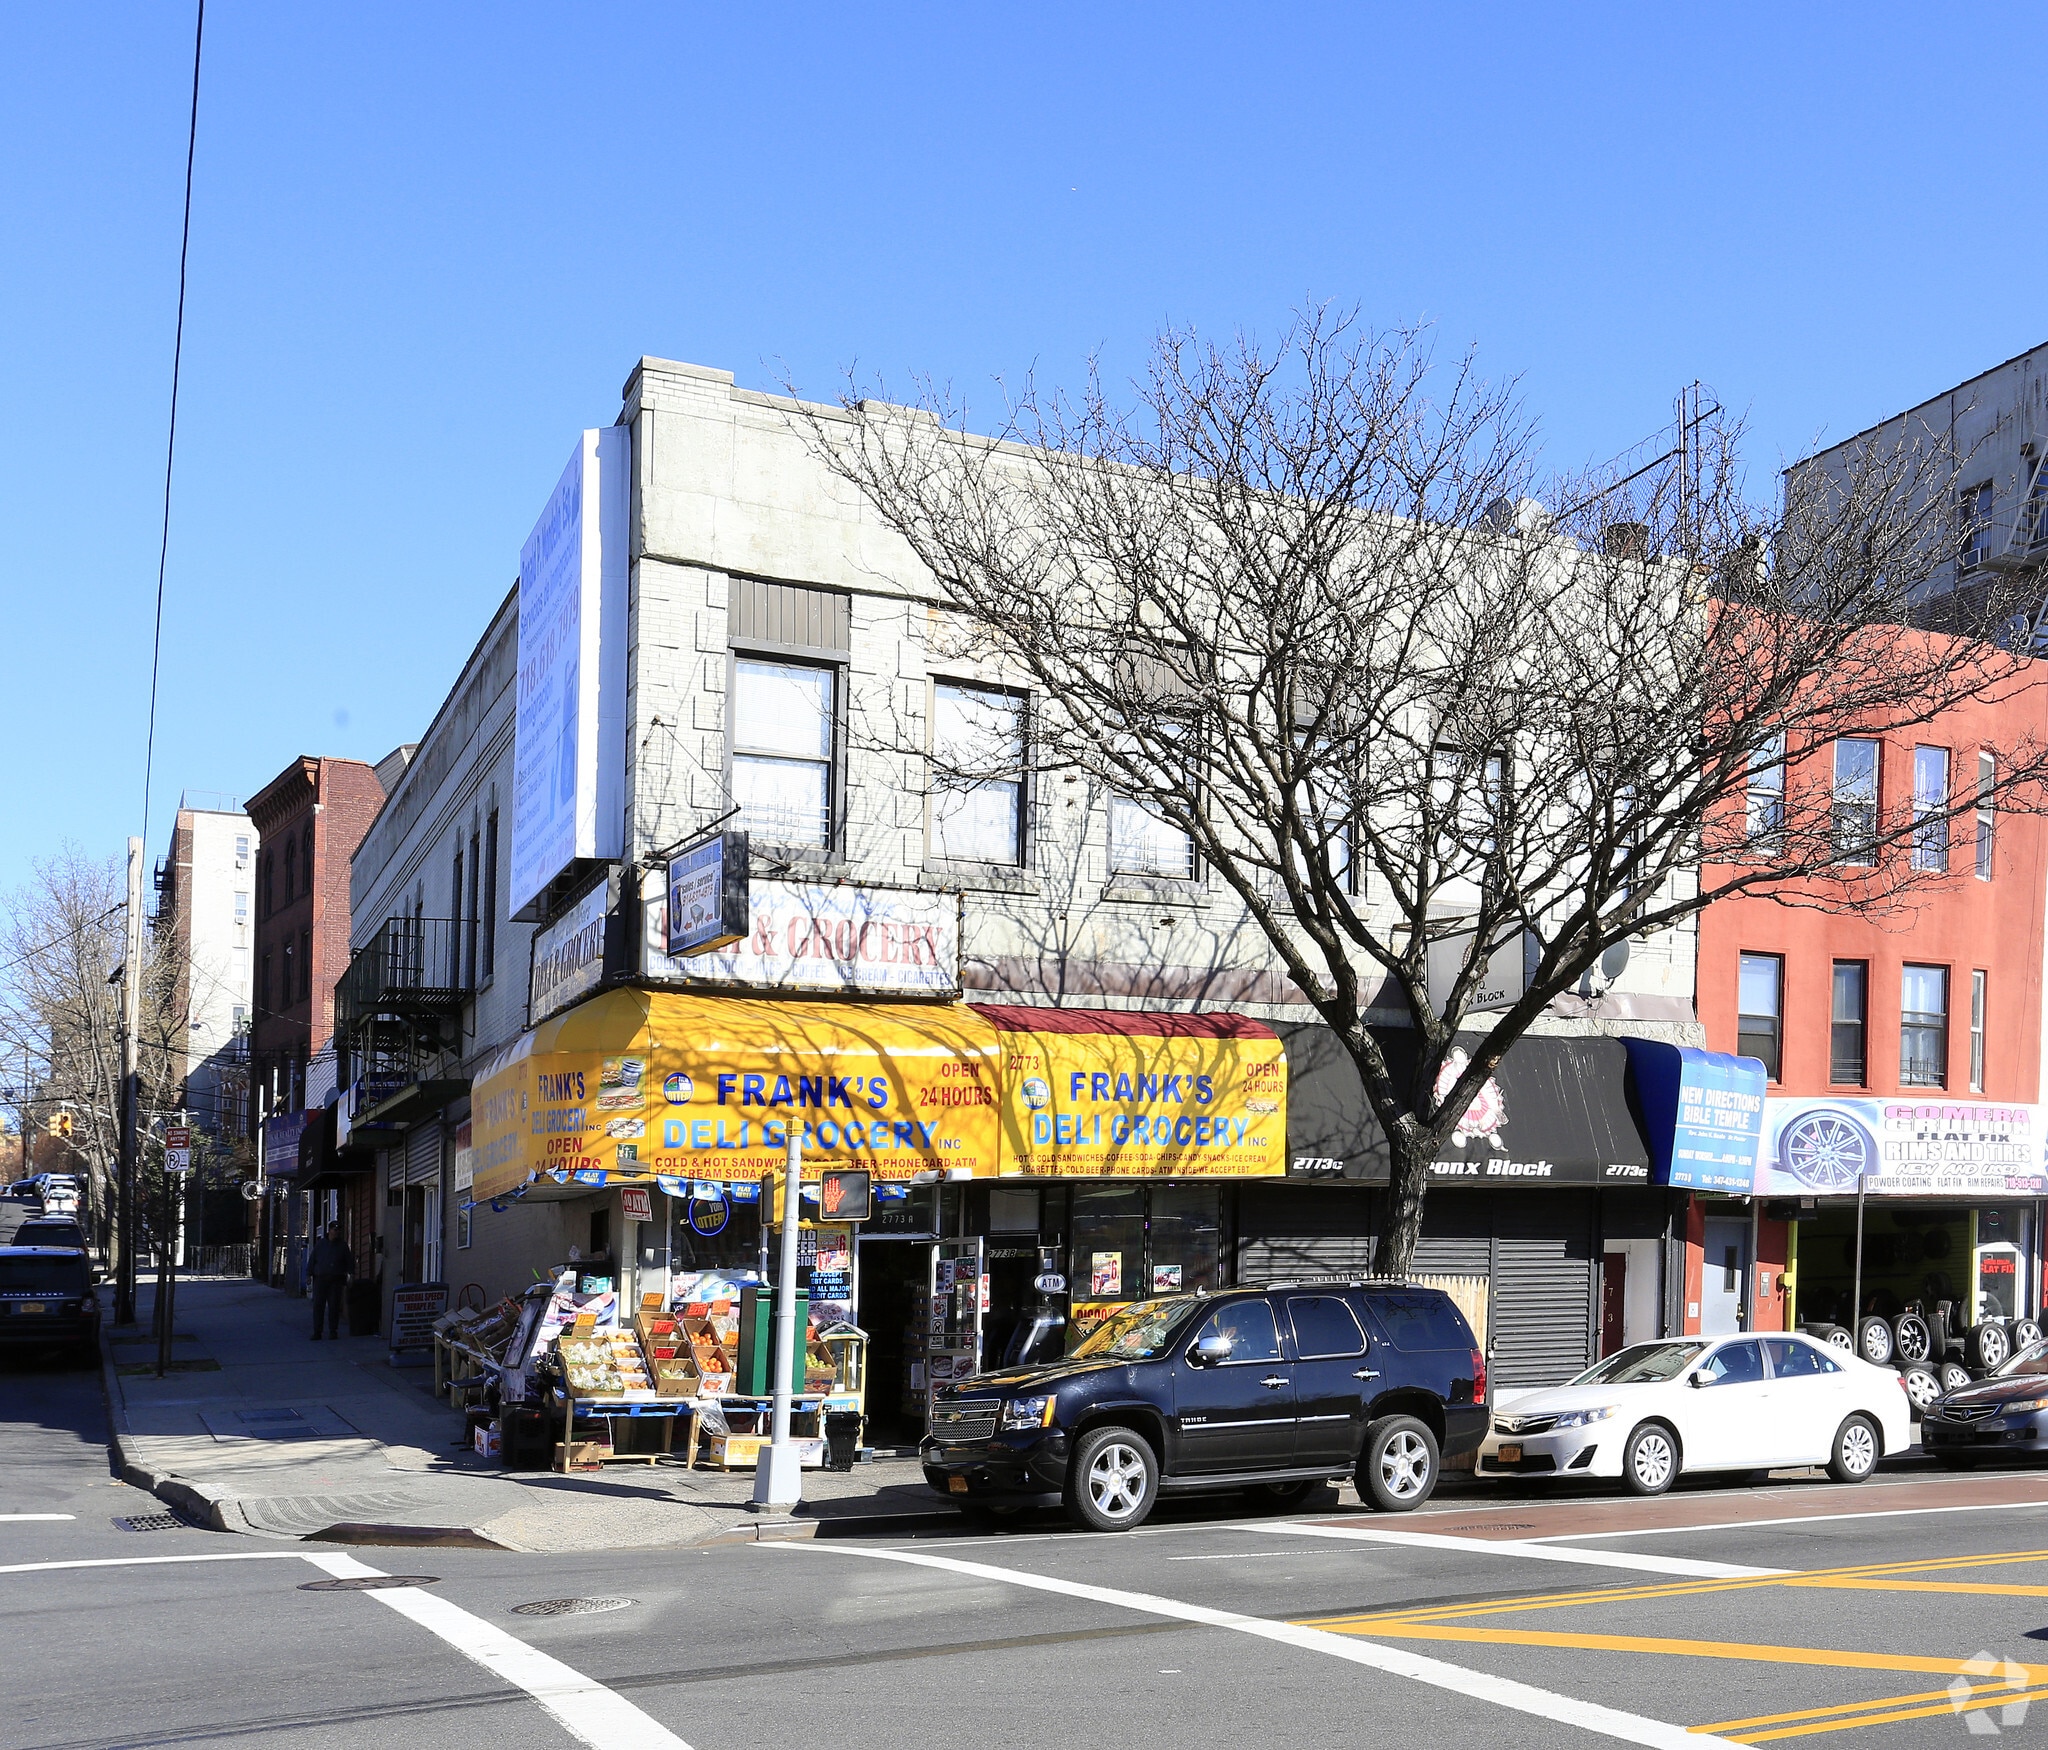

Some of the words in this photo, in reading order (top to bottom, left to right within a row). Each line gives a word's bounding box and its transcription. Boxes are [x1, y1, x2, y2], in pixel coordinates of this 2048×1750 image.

[518, 582, 578, 710] 718.618.7979
[752, 915, 778, 956] &
[787, 915, 943, 967] GROCERY
[649, 955, 676, 971] COLD
[680, 958, 705, 972] BEER
[792, 964, 827, 979] COFFEE
[856, 967, 887, 982] CREAM
[898, 970, 951, 986] CIGARETTES
[941, 1062, 979, 1078] OPEN
[1010, 1055, 1040, 1070] 2773
[1246, 1062, 1280, 1077] OPEN
[538, 1071, 585, 1102] FRANK'S
[717, 1073, 889, 1109] FRANK'S
[1071, 1071, 1213, 1104] FRANK'S
[1243, 1081, 1253, 1093] 24
[1254, 1081, 1284, 1093] HOURS
[920, 1087, 938, 1106] 24
[941, 1086, 993, 1106] HOURS
[1681, 1085, 1704, 1104] NEW
[1705, 1089, 1760, 1113] DIRECTIONS
[531, 1111, 545, 1135] DELI
[546, 1108, 586, 1133] GROCERY
[1683, 1105, 1711, 1125] BIBLE
[1714, 1109, 1750, 1130] TEMPLE
[1884, 1105, 2030, 1123] GOMERA
[664, 1119, 749, 1149] DELI
[762, 1119, 939, 1150] GROCERY
[938, 1138, 962, 1150] INC
[1034, 1113, 1101, 1145] DELI
[1111, 1114, 1250, 1147] GROCERY
[1248, 1137, 1268, 1146] INC
[1917, 1132, 1972, 1141] FLAT
[1979, 1133, 2010, 1142] FIX
[547, 1137, 583, 1154] OPEN
[1885, 1141, 1942, 1161] RIMS
[1944, 1142, 1984, 1162] AND
[1986, 1143, 2032, 1163] TIRES
[655, 1157, 688, 1167] COLD
[691, 1157, 700, 1167] &
[703, 1157, 728, 1167] HOT
[1013, 1154, 1028, 1163] HOT
[1037, 1154, 1056, 1163] COLD
[1244, 1154, 1267, 1163] CREAM
[680, 1168, 722, 1179] CREAM
[1210, 1165, 1236, 1173] ACCEPT
[1237, 1165, 1250, 1173] EBT
[1486, 1158, 1553, 1177] Block
[1896, 1163, 1939, 1175] NEW
[1943, 1163, 1979, 1175] AND
[1981, 1164, 2020, 1177] USED
[1869, 1177, 1900, 1187] POWDER
[1902, 1177, 1932, 1187] COATING
[1937, 1177, 1951, 1187] FLAT
[1953, 1177, 1963, 1187] FIX
[1967, 1177, 1980, 1187] RIM
[1980, 1177, 2004, 1188] REPAIRS
[632, 1194, 650, 1213] ATM
[882, 1215, 905, 1224] 2773
[908, 1215, 914, 1223] A
[2001, 1263, 2015, 1273] FIX
[823, 1277, 843, 1285] CARDS
[829, 1285, 850, 1293] MAJOR
[1042, 1278, 1060, 1288] ATM
[1180, 1416, 1207, 1424] TAHOE
